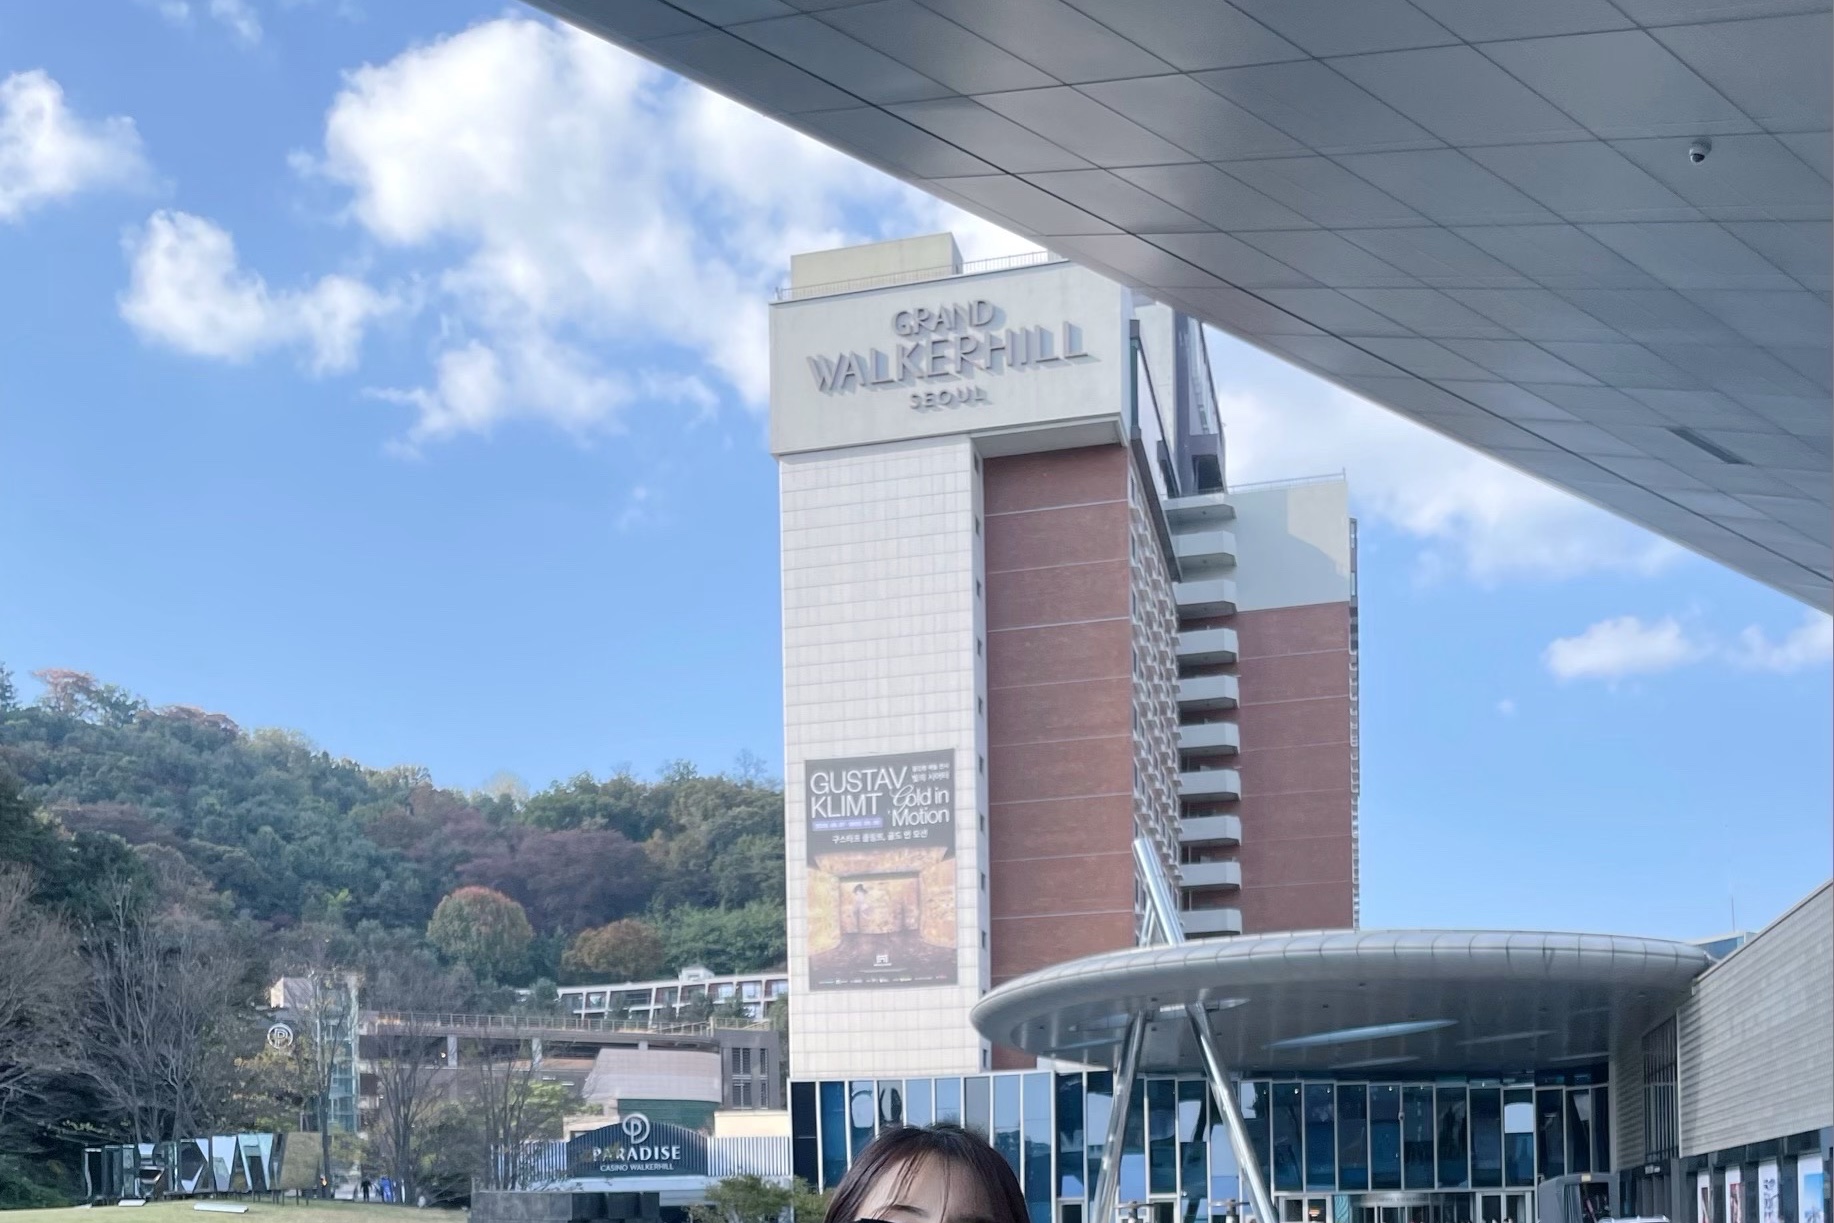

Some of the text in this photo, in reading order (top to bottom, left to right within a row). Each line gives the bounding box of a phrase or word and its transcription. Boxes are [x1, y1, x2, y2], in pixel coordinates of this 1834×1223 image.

[892, 300, 996, 337] GRAND
[806, 320, 1090, 392] WALKERHILL
[909, 388, 990, 410] SEOUL
[810, 766, 908, 795] GUSTAV
[811, 792, 883, 819] KLIMT
[889, 784, 950, 814] Gold in
[892, 807, 950, 827] Motion
[592, 1145, 681, 1161] PARADISE
[600, 1162, 674, 1172] CASINO WALKERHILL
